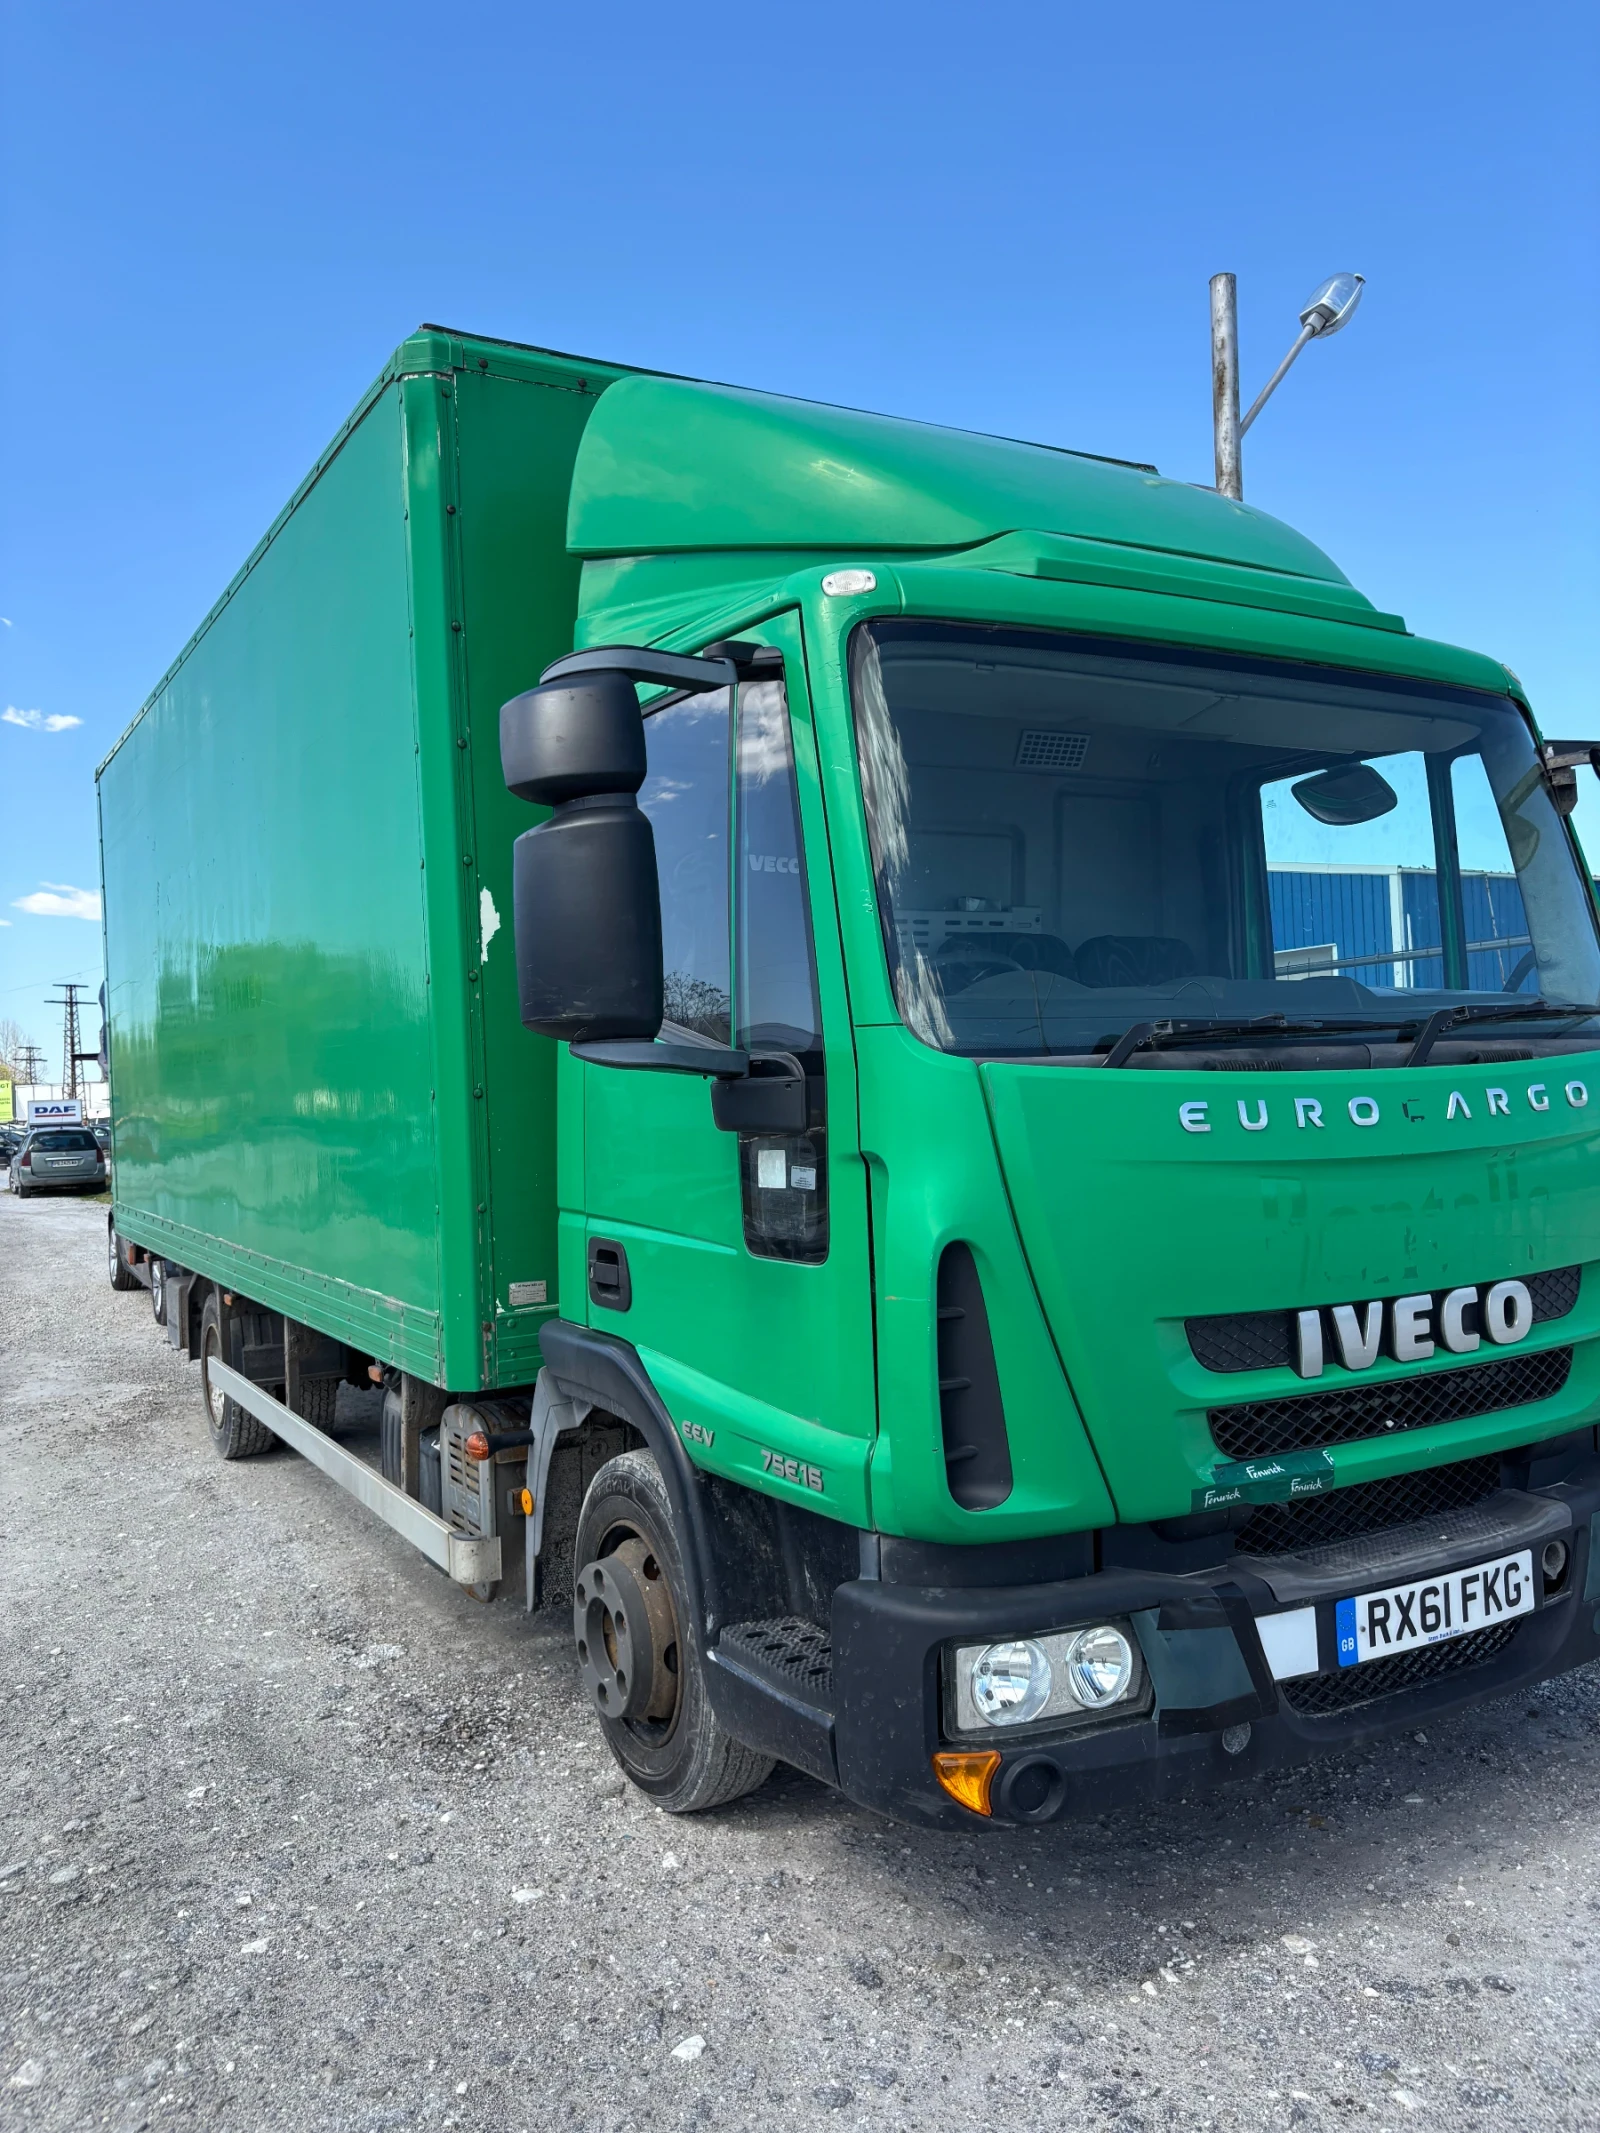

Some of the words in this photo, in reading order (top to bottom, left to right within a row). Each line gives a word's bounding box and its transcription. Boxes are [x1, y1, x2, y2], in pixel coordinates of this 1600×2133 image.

[34, 1105, 76, 1114] DAF
[1297, 1280, 1533, 1379] IVECO
[682, 1420, 715, 1447] EEV
[761, 1449, 824, 1492] 75E16
[1246, 1462, 1286, 1479] Fenwick
[1290, 1477, 1323, 1496] Fenwick
[1204, 1487, 1241, 1508] Fenwick
[1460, 1561, 1523, 1623] FKG
[1341, 1637, 1355, 1652] GB
